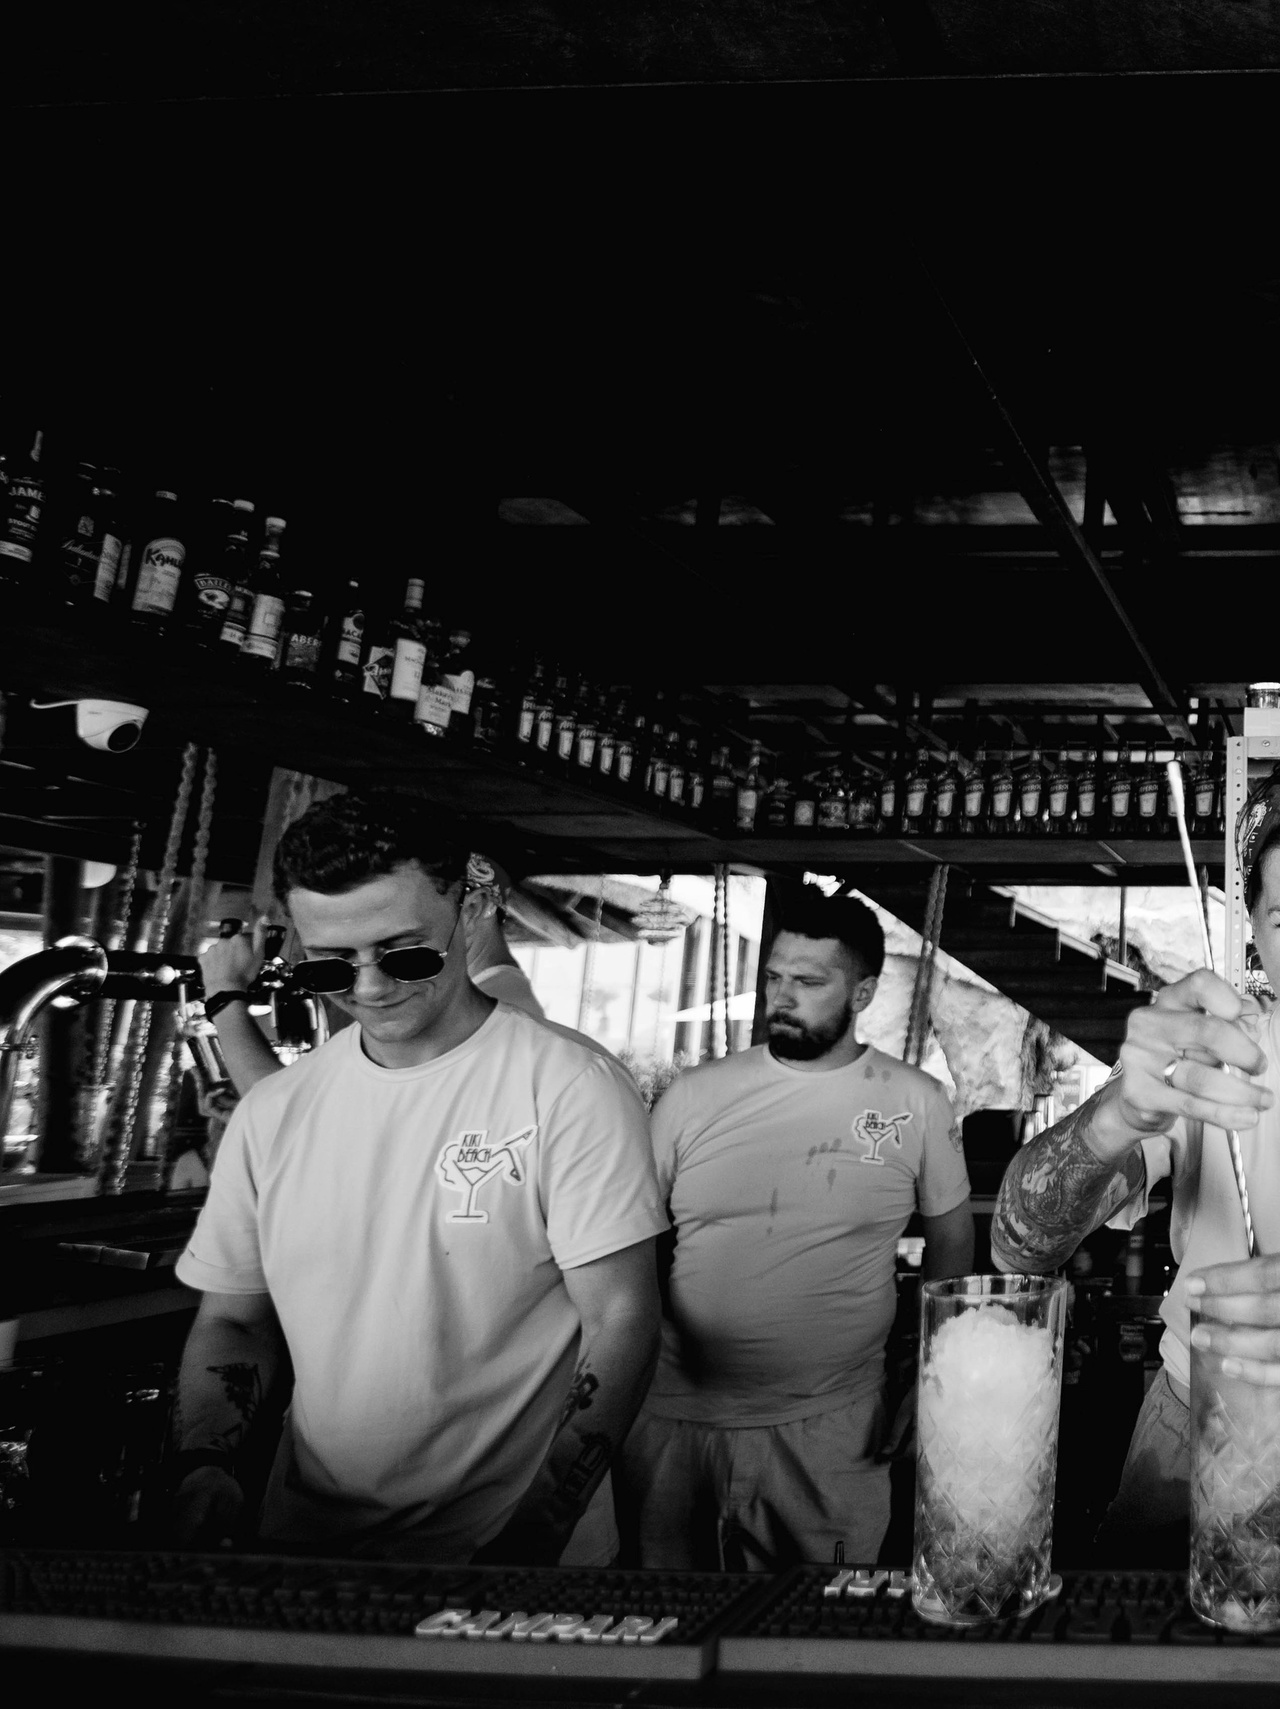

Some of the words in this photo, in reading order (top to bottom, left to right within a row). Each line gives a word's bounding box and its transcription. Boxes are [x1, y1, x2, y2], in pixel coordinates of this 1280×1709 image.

[461, 1133, 482, 1148] KIKI
[457, 1148, 492, 1163] BEACH
[414, 1608, 679, 1645] CAMPARI
